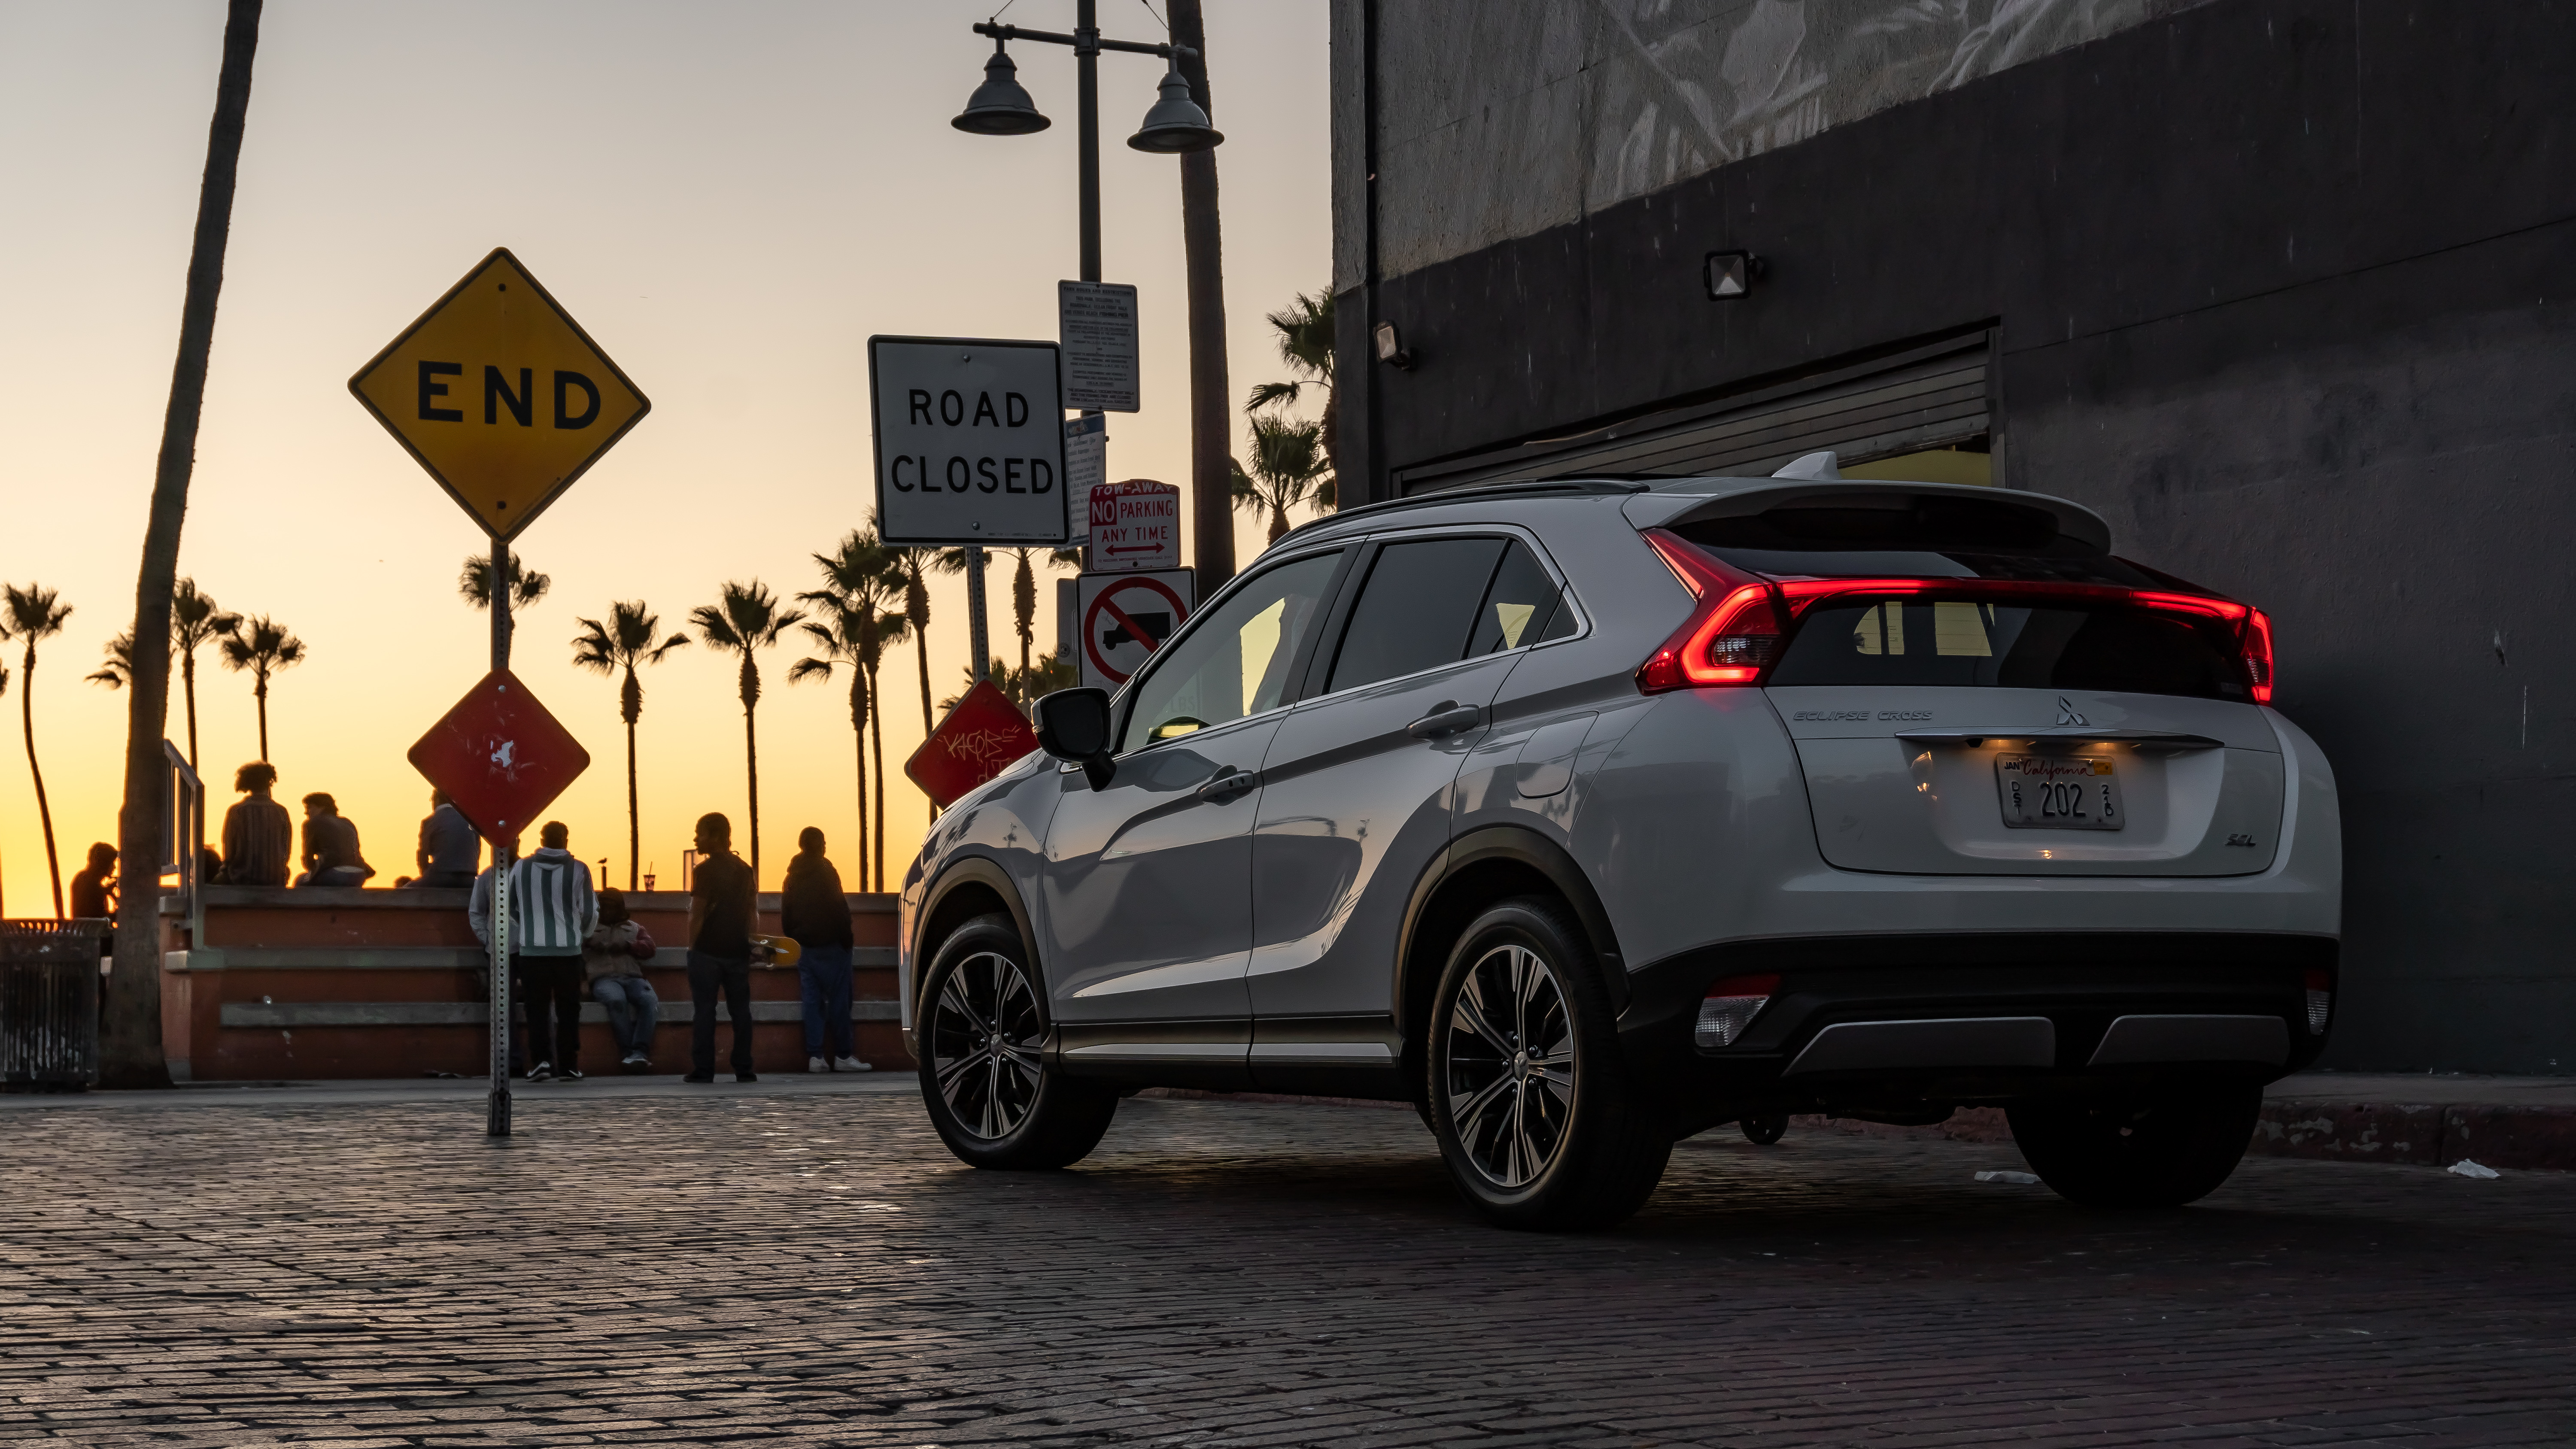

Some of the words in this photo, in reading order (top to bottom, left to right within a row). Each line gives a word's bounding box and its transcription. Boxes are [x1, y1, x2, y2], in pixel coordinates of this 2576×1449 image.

[418, 360, 601, 430] END
[908, 388, 1029, 428] ROAD
[891, 455, 1054, 494] CLOSED
[1096, 482, 1173, 496] TOW-AWAY
[1092, 500, 1115, 523] NO
[1120, 500, 1173, 518] PARKING
[1101, 527, 1128, 543] ANY
[1135, 525, 1169, 541] TIME
[1792, 710, 1870, 721] ECLIPSE
[1877, 710, 1933, 721] CROSS
[2004, 761, 2020, 770] JAN
[2023, 759, 2095, 781] California
[2039, 782, 2086, 817] 202
[2224, 834, 2256, 846] SEL
